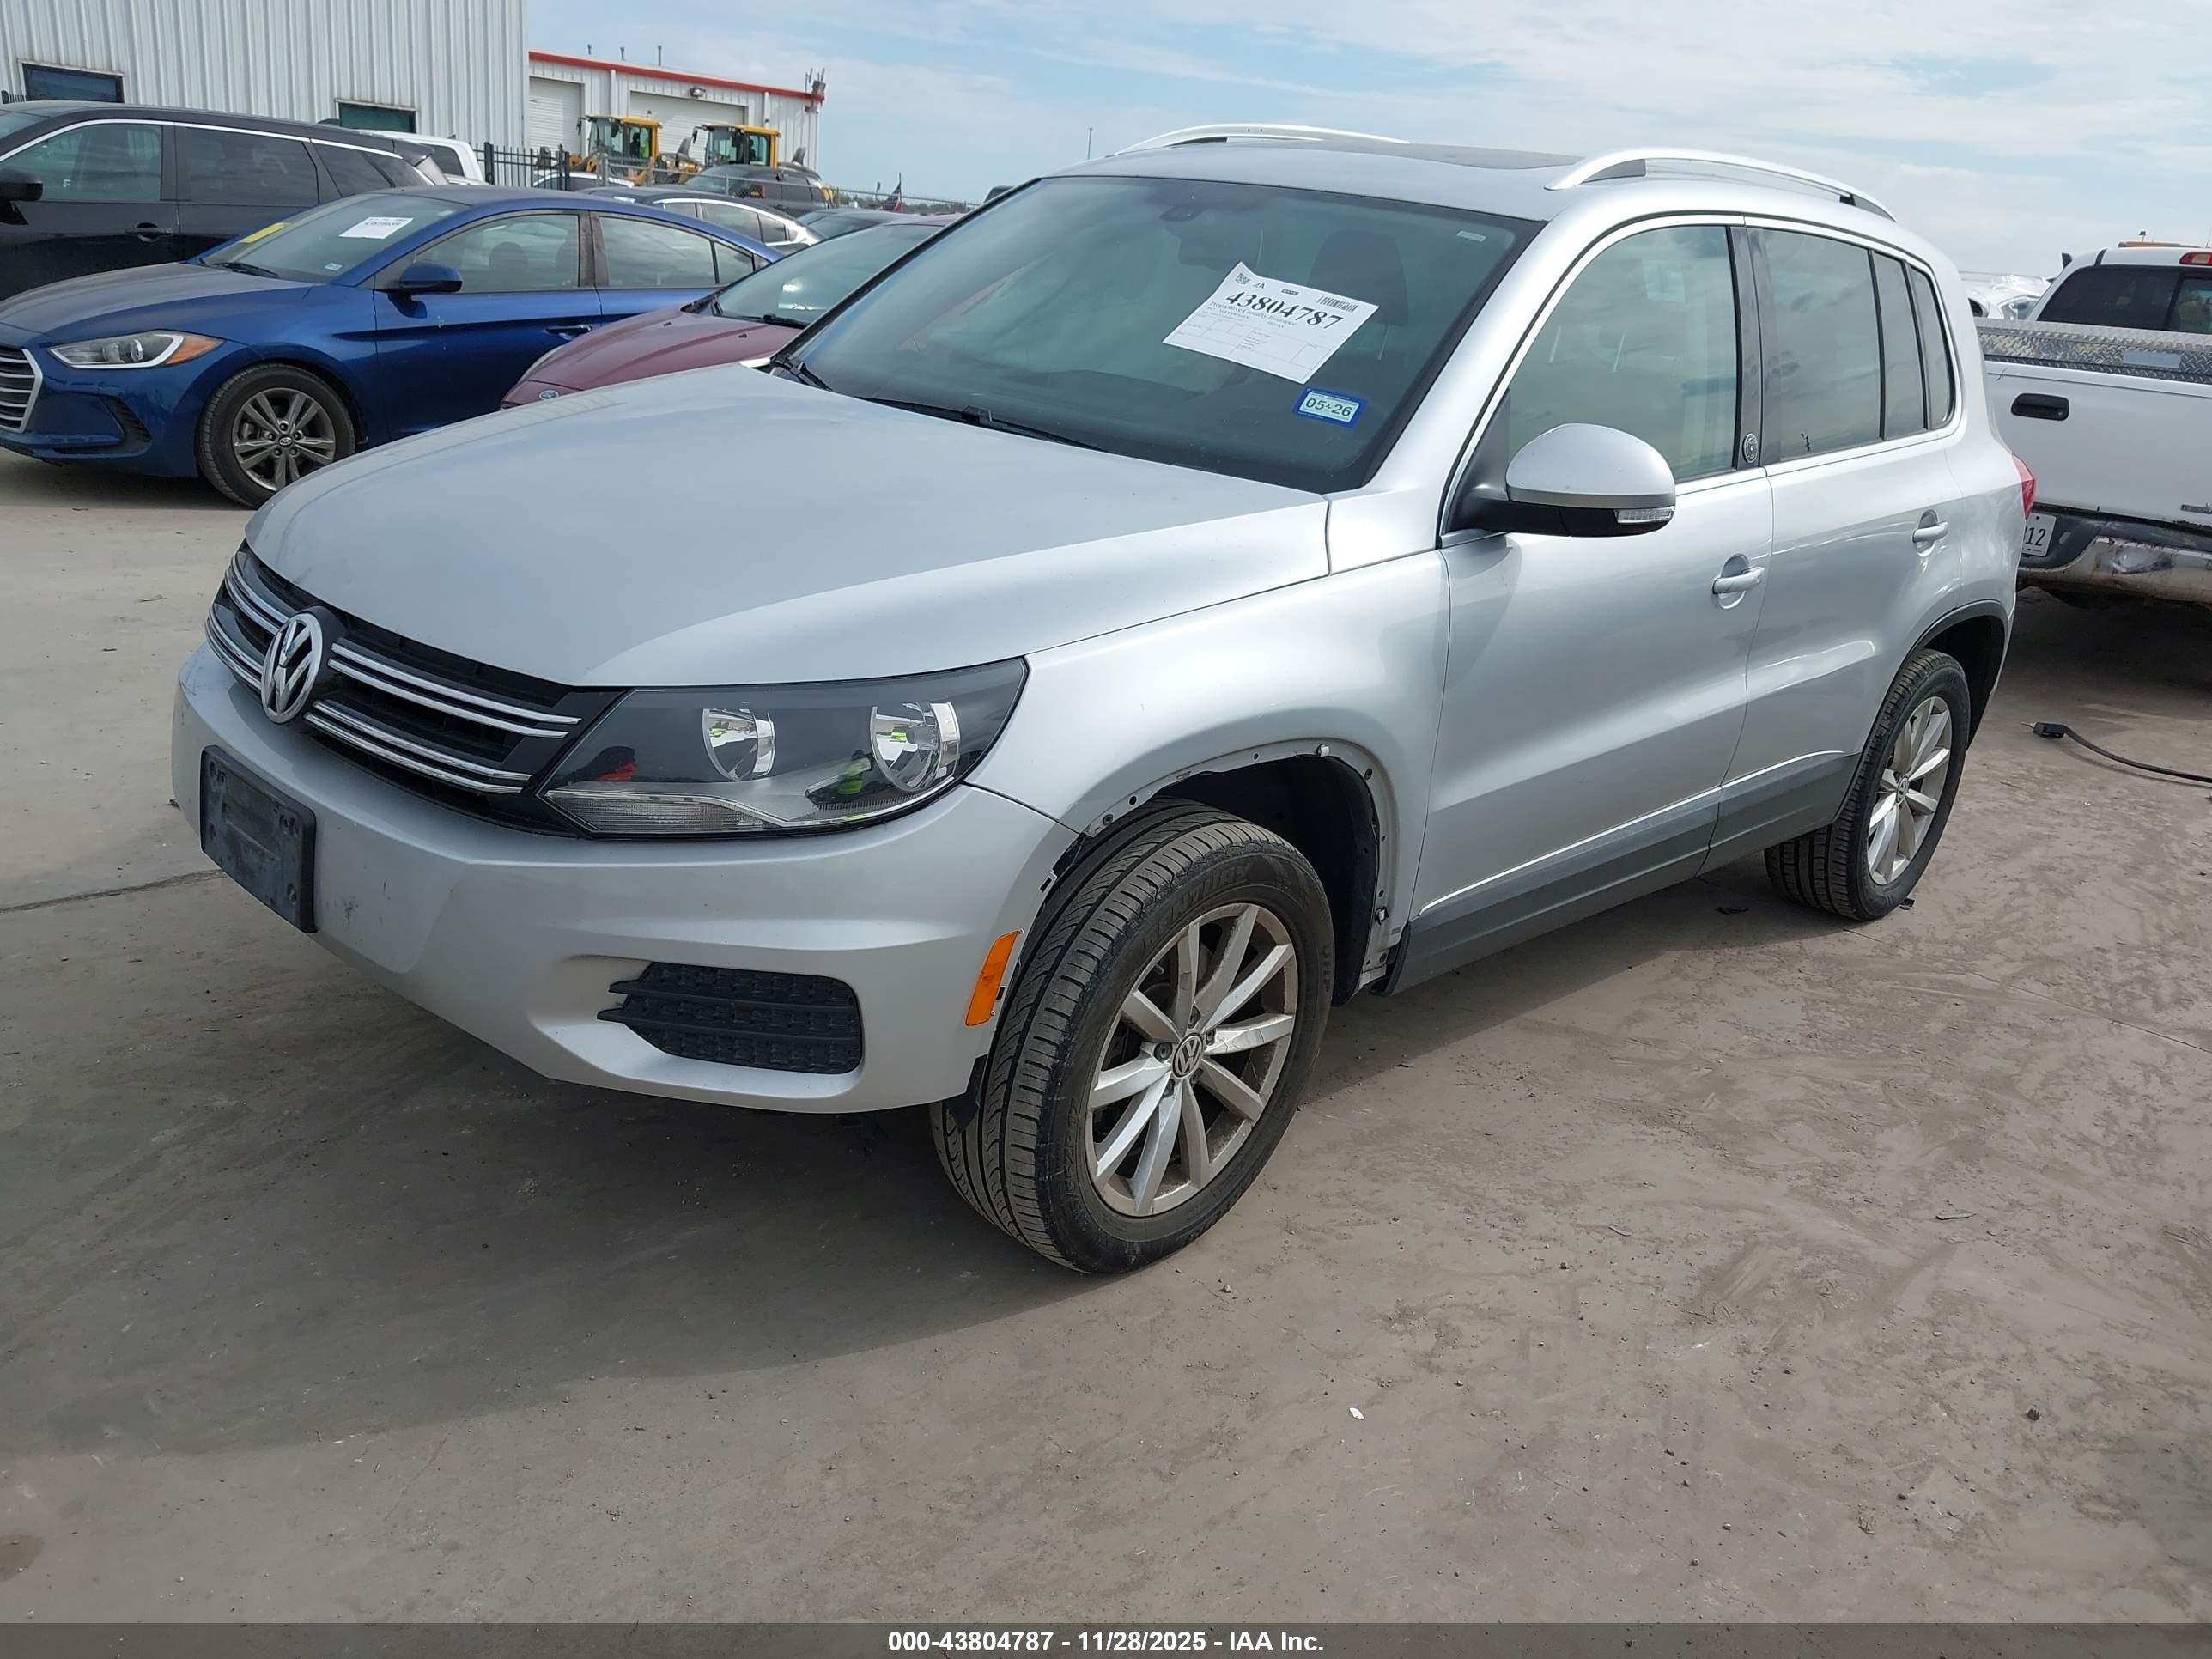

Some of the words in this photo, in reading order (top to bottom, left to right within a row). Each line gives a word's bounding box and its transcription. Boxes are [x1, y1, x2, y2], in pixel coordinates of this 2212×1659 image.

[1225, 292, 1345, 330] 43804787
[1305, 398, 1327, 410] 05
[1331, 404, 1353, 417] 26
